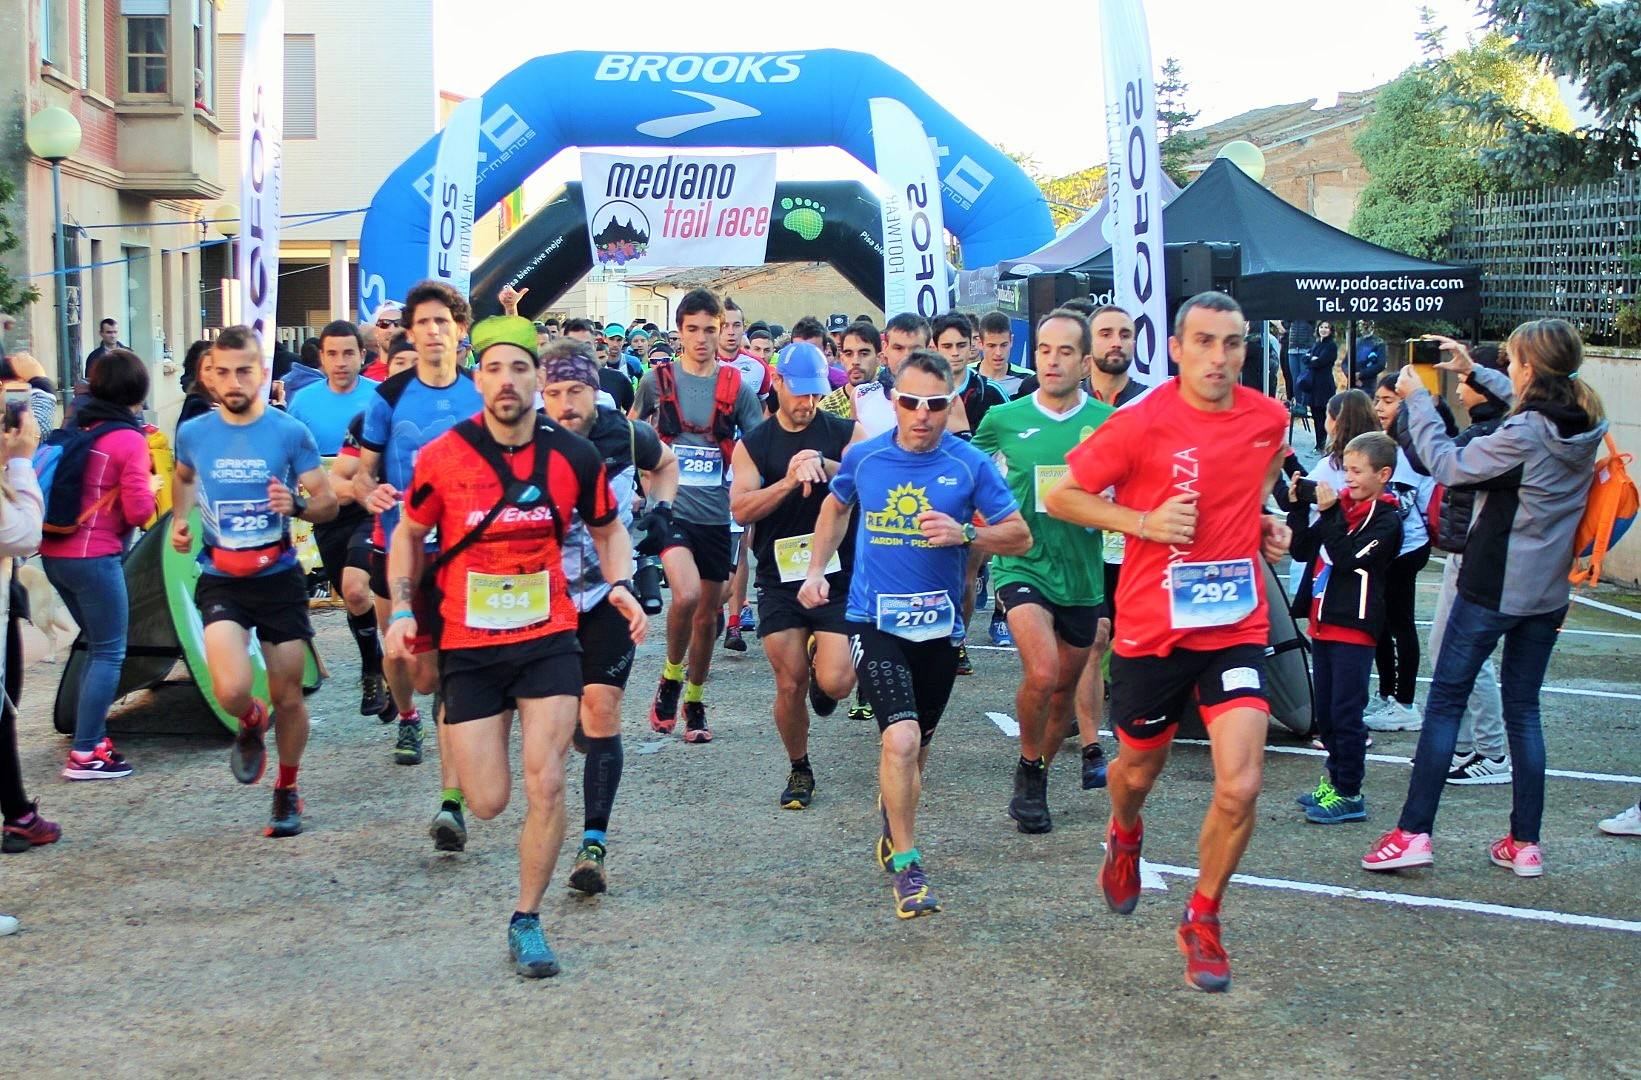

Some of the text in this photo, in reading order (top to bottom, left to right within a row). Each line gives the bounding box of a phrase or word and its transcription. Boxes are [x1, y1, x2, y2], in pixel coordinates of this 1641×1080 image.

[594, 54, 806, 83] BROOKS
[475, 129, 536, 185] ormenos
[606, 156, 736, 200] medrano
[250, 85, 268, 332] OFOS
[662, 200, 770, 239] trail race
[438, 182, 458, 278] FOS
[516, 266, 535, 280] bien,
[532, 253, 547, 266] vive
[545, 236, 563, 255] mejor
[361, 269, 386, 324] KS
[1296, 276, 1464, 293] www.podoactiva.com
[1317, 296, 1443, 312] Tel. 902 365 099
[684, 459, 714, 473] 288
[1172, 447, 1200, 498] AZA
[231, 515, 269, 531] 226
[867, 514, 922, 531] REMA
[869, 536, 903, 546] JARDIN
[486, 591, 531, 609] 494
[1191, 581, 1239, 604] 292
[896, 610, 938, 627] 270
